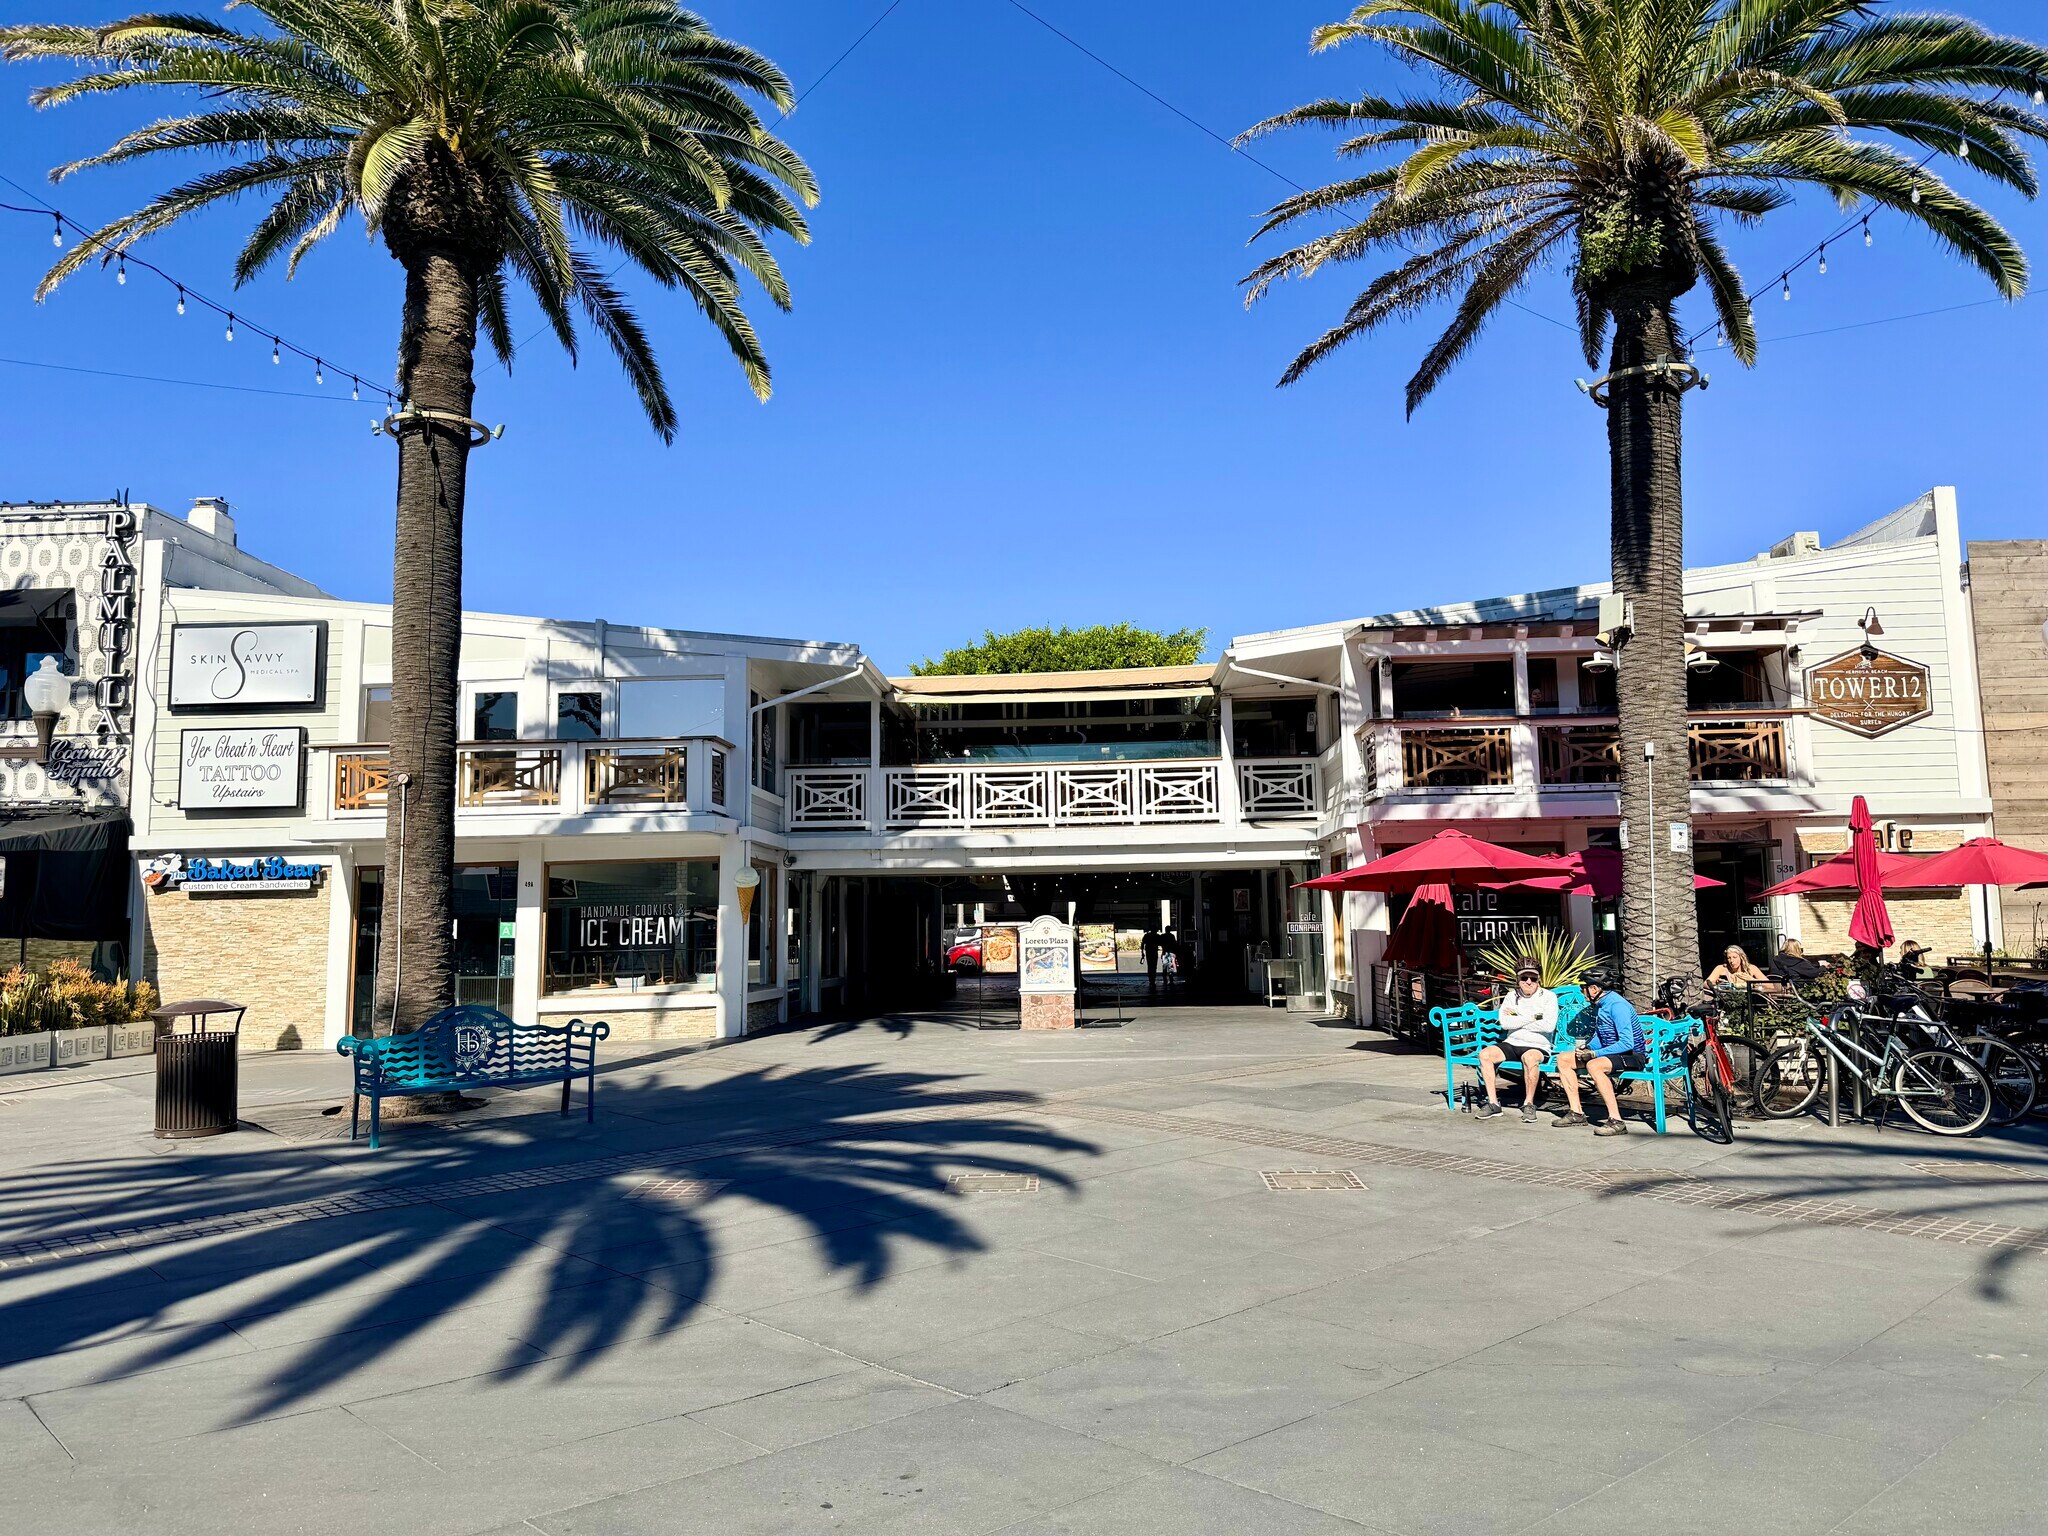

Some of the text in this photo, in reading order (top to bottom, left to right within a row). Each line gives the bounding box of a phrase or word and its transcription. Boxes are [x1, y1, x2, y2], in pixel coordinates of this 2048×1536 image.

[91, 511, 132, 735] PALMILLA
[190, 654, 226, 665] SKIN
[1814, 676, 1921, 699] TOWER12
[51, 740, 111, 760] Cocina
[187, 734, 295, 767] Yer Cheat'n Heart
[47, 760, 120, 786] Tequila
[199, 764, 281, 782] TATTOO
[212, 784, 266, 802] Upstairs
[1872, 822, 1913, 848] afe
[170, 855, 320, 881] The Baked Bear
[182, 880, 308, 890] Custom Ice Cream Sandwiches
[580, 903, 685, 918] HANDMADE COOKIES &
[1300, 911, 1317, 921] cafe
[502, 926, 510, 935] A
[580, 916, 684, 947] ICE CREAM
[1290, 923, 1323, 932] BONAPART
